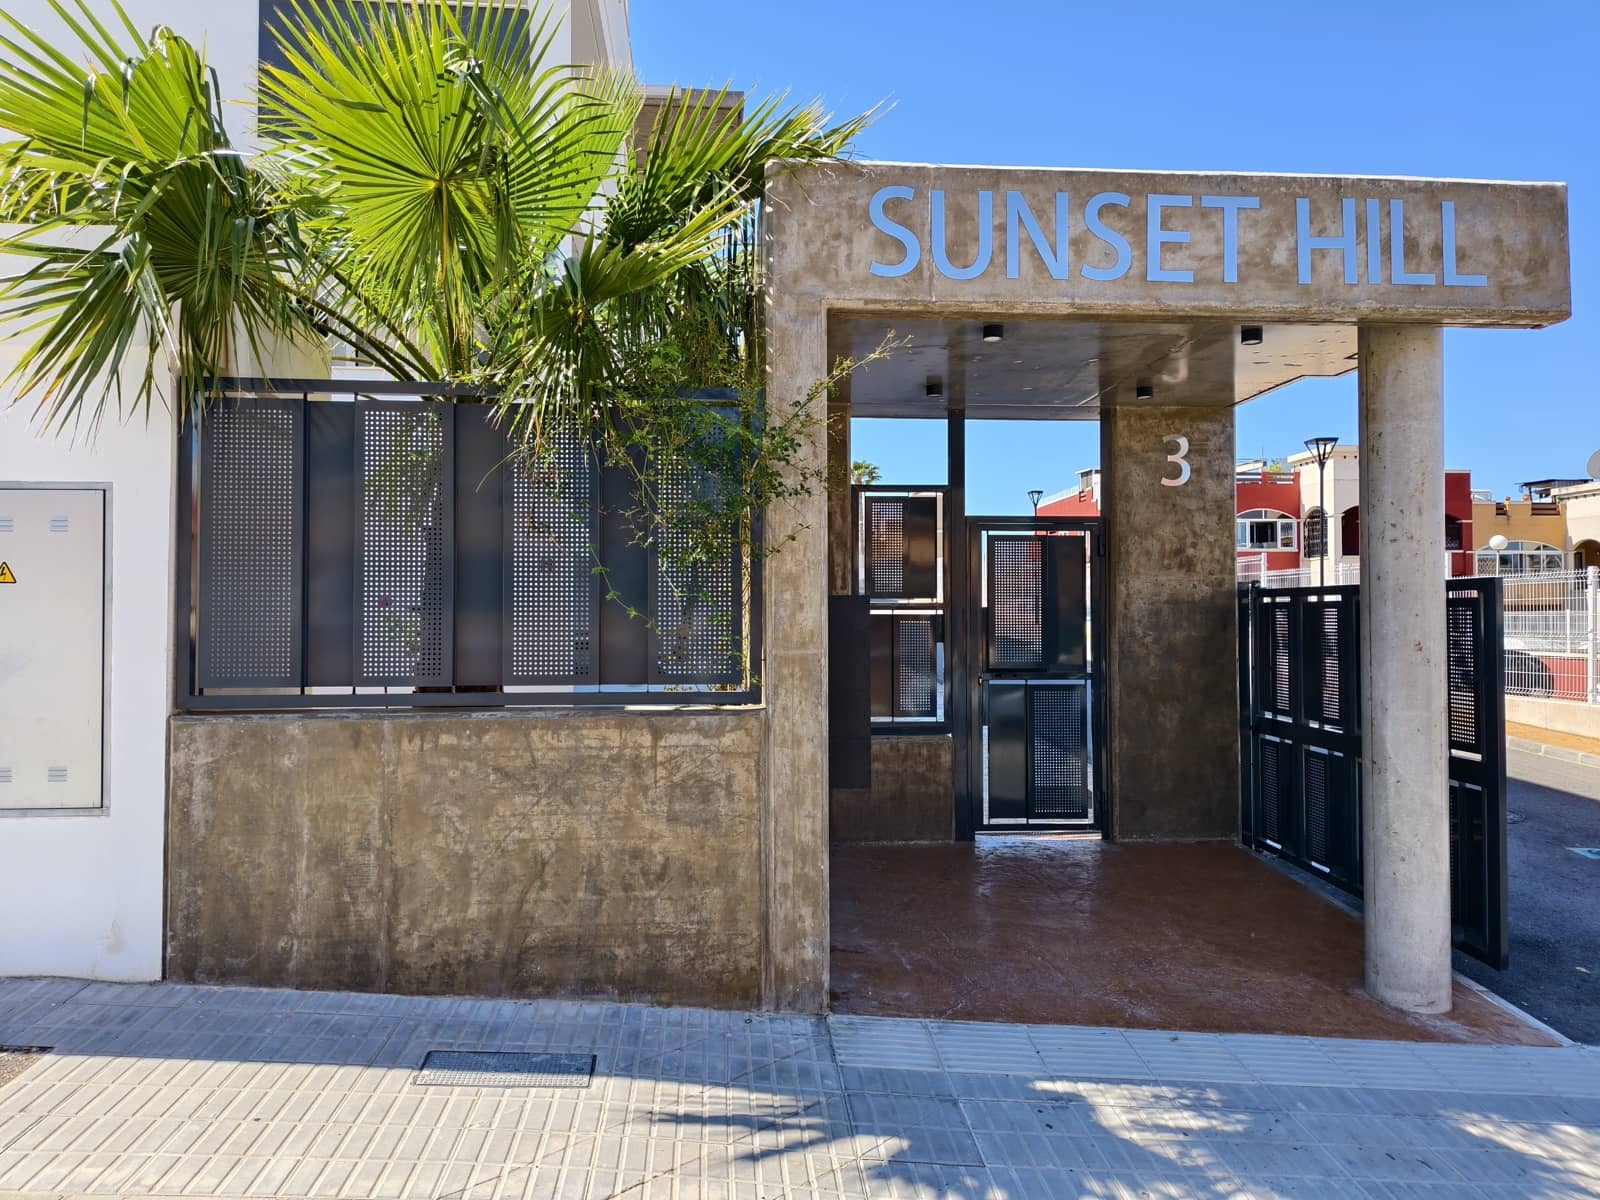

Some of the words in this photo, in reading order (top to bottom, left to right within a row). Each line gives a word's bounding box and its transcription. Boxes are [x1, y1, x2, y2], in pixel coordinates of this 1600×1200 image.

[869, 185, 1260, 283] SUNSET
[1296, 198, 1488, 287] HILL
[1160, 434, 1192, 487] 3
